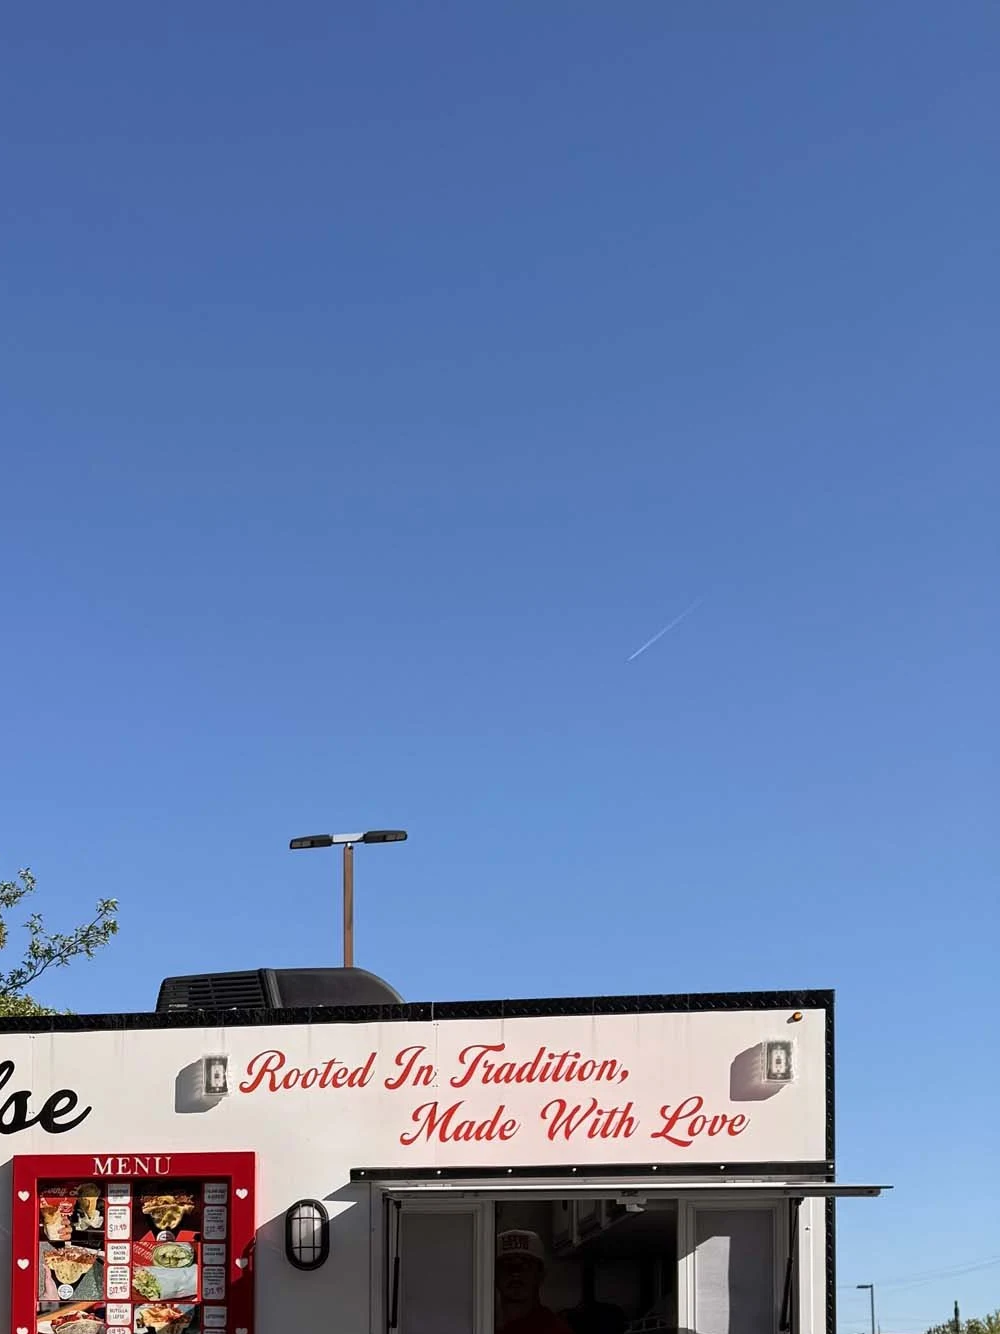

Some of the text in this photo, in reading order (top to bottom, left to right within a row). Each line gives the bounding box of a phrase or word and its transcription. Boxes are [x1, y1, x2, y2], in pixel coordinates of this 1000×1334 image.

[240, 1043, 630, 1093] Rooted In Tradition,
[400, 1096, 750, 1147] Made With Love
[93, 1157, 171, 1175] MENU
